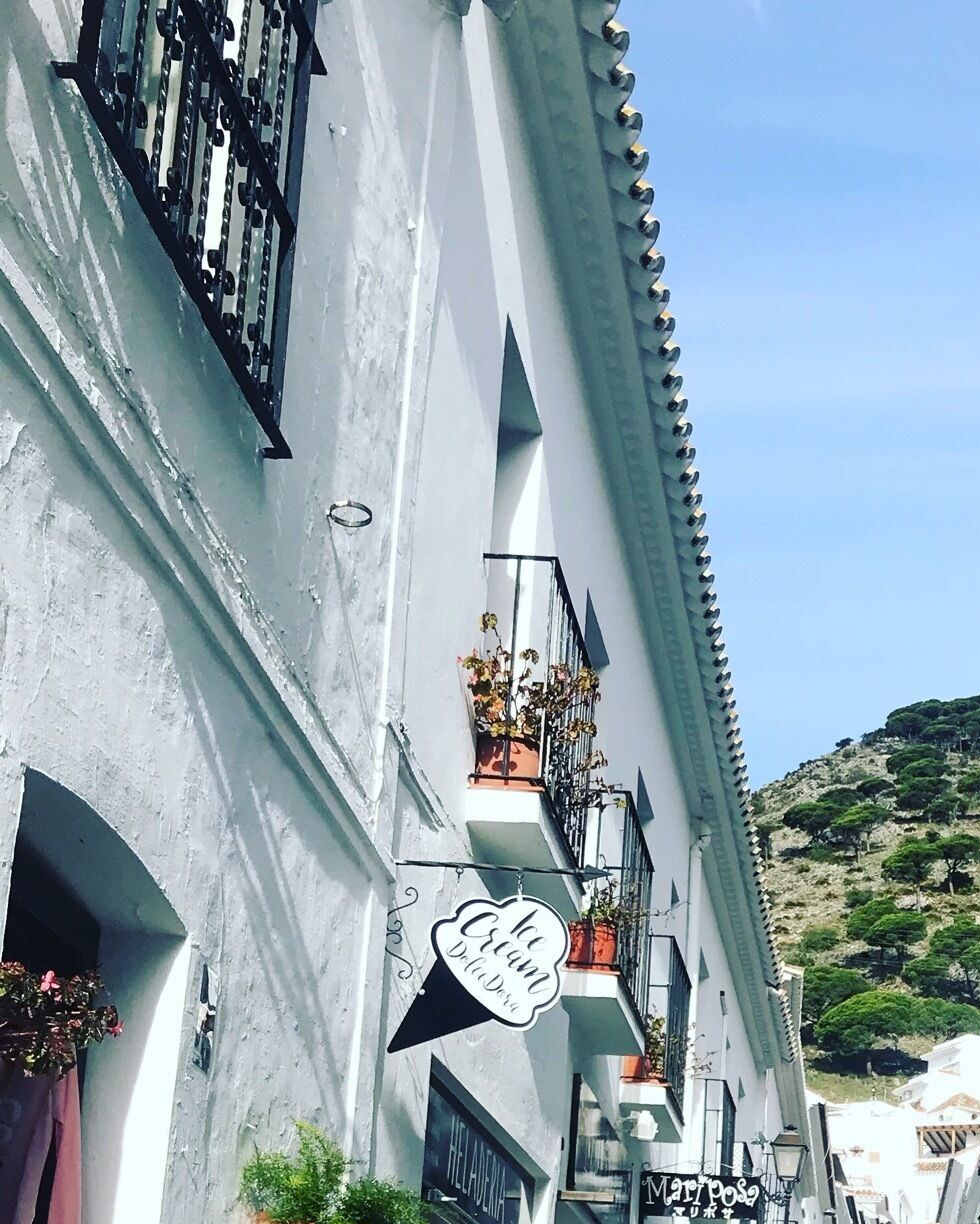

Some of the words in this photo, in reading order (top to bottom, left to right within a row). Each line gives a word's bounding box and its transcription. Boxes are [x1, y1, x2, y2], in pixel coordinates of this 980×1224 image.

[510, 908, 547, 952] Ice
[459, 911, 551, 995] Cream
[642, 1175, 759, 1207] Mariposa
